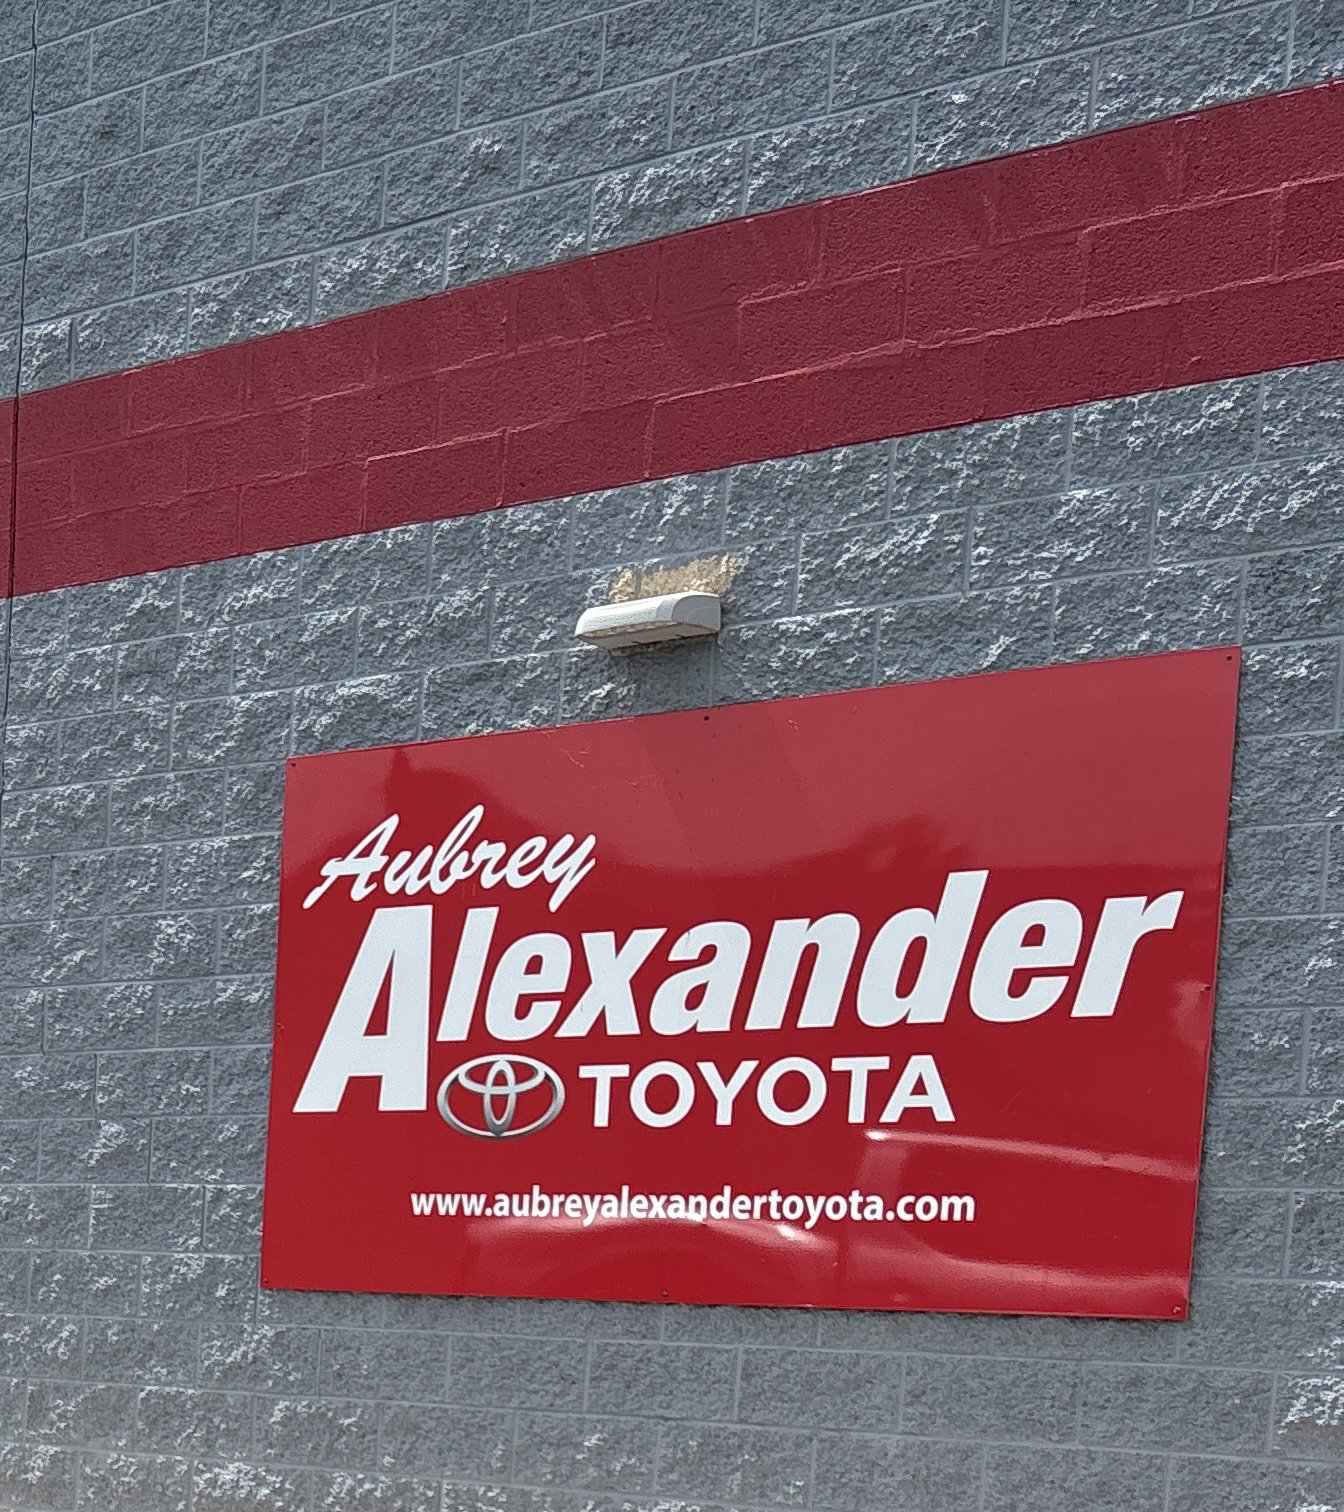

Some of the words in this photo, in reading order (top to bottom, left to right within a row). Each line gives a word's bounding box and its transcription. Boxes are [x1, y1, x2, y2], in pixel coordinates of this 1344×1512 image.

[302, 804, 596, 913] Aubrey
[292, 869, 1185, 1113] Alexander
[578, 1053, 956, 1129] TOYOTA
[410, 1186, 976, 1228] www.aubreyalexandertoyota.com
